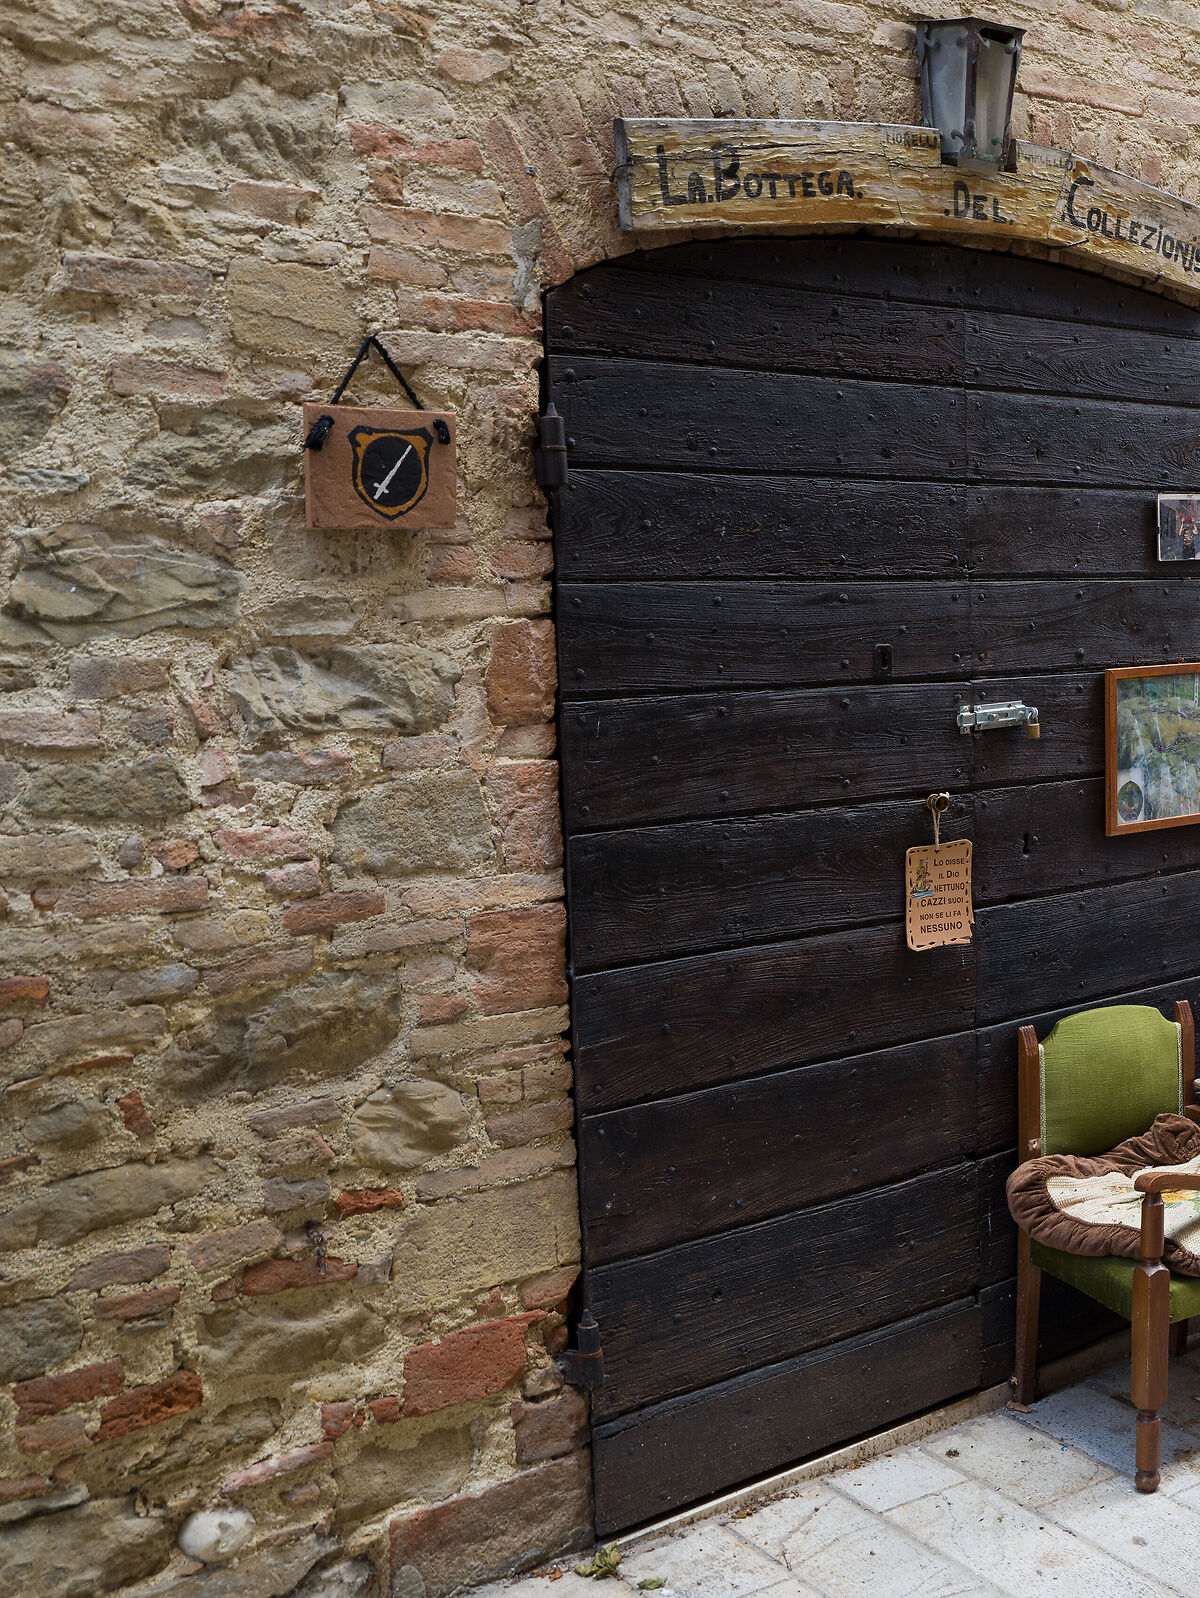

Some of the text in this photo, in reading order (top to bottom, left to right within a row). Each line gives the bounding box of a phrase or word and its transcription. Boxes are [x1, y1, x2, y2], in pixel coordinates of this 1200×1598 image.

[934, 858, 965, 867] LO DISSE
[947, 870, 960, 878] DIO
[934, 882, 965, 892] NETTUNO
[920, 897, 946, 908] CAZZI
[948, 897, 964, 905] SUOI
[920, 913, 934, 921] NON
[920, 921, 963, 934] NESSUNO
